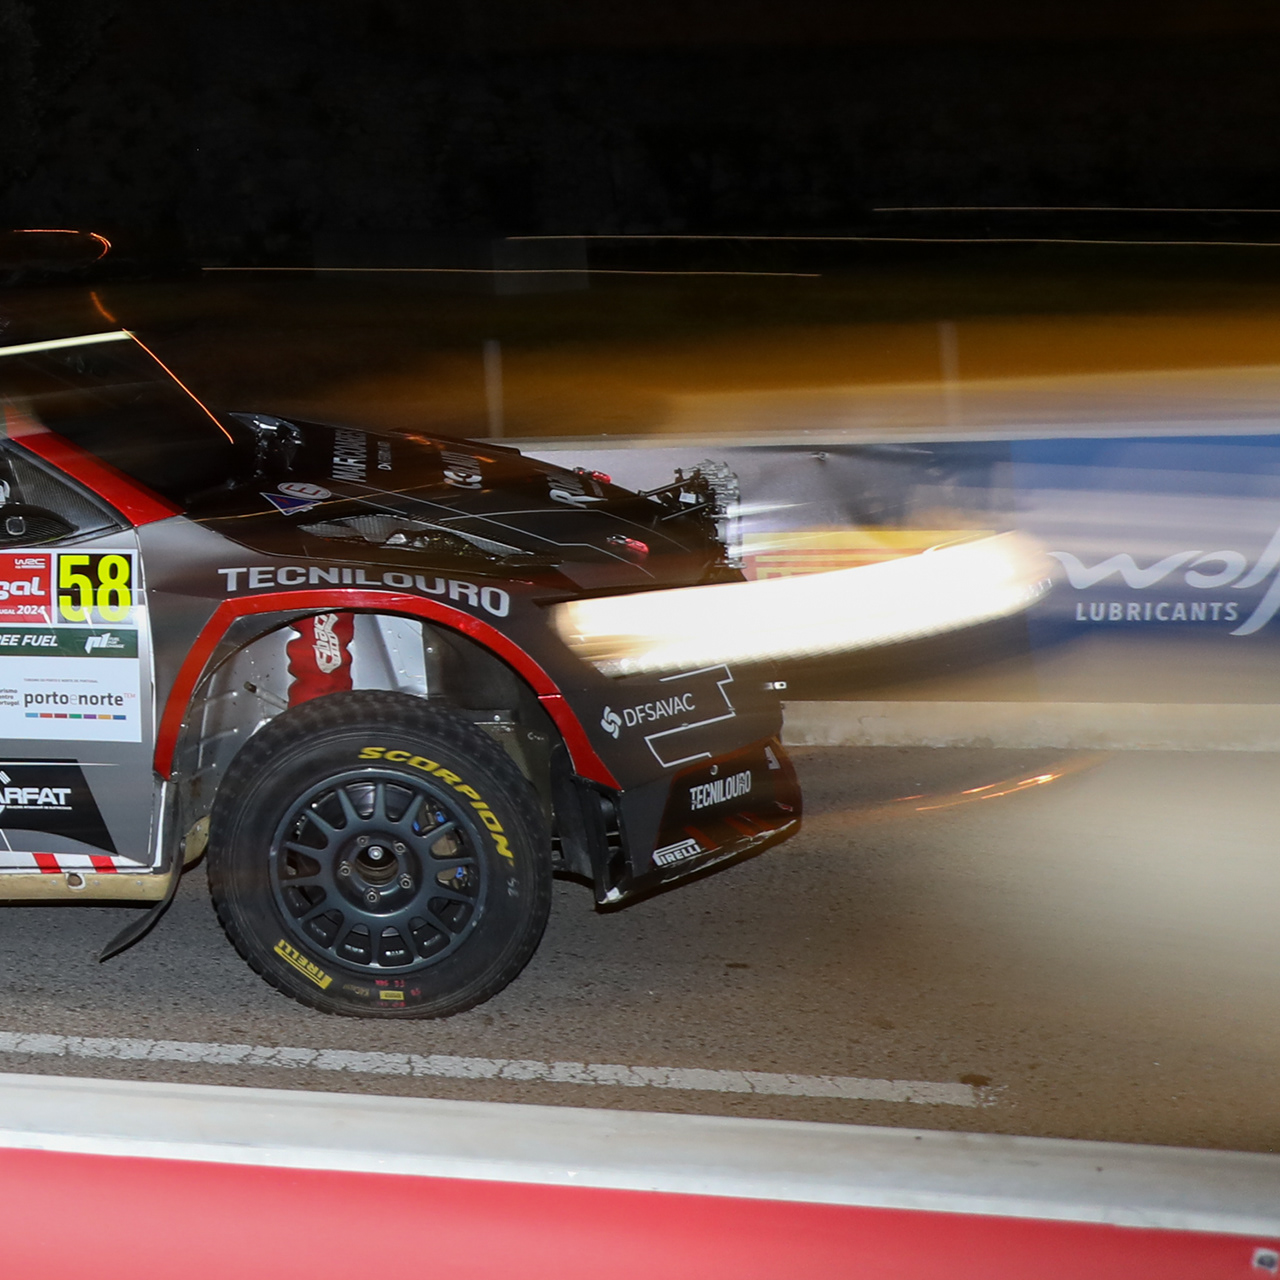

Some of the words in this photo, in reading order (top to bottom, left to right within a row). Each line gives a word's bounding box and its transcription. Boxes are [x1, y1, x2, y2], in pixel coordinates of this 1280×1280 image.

[58, 554, 132, 622] 58
[217, 566, 511, 618] TECNILOURO
[17, 605, 46, 615] 2024
[1076, 601, 1239, 622] LUBRICANTS
[22, 635, 59, 648] FUEL
[623, 692, 696, 727] DFSAVAC
[359, 745, 514, 858] SCORPION
[689, 770, 752, 811] TECNILOURO
[652, 837, 702, 866] PIRELLI
[273, 938, 333, 990] PIRELLI
